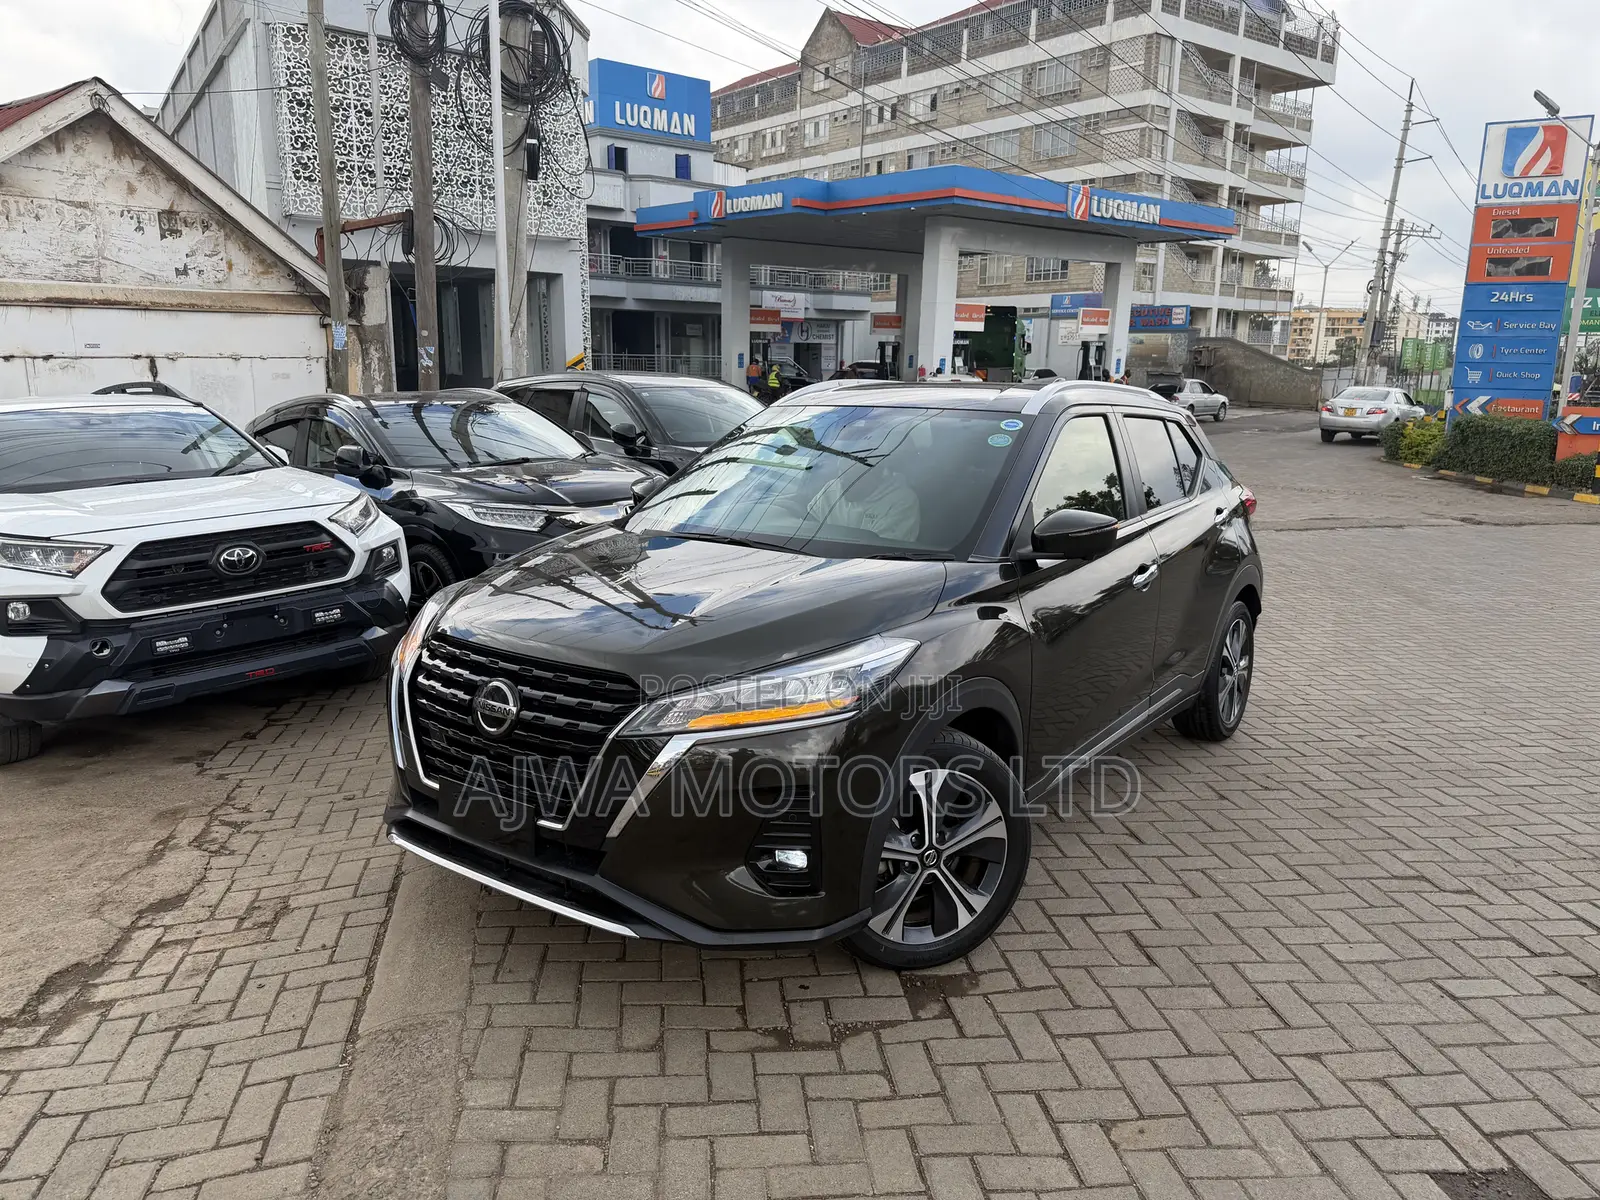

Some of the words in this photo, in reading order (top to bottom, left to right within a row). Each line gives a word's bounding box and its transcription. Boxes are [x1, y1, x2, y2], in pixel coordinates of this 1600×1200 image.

[614, 100, 696, 137] LUQMAN
[1480, 179, 1580, 199] LUQMAN
[726, 192, 784, 214] LUQMAN
[1091, 196, 1161, 224] LUQMAN
[1492, 208, 1520, 216] Diesel
[1487, 246, 1530, 255] Unleaded
[1490, 291, 1534, 303] 24Hrs
[1503, 321, 1536, 329] Service
[1539, 321, 1557, 331] Bay
[1500, 346, 1519, 355] Tyre
[1520, 346, 1548, 355] Center
[1496, 370, 1519, 379] Quick
[1520, 371, 1541, 380] Shop
[1491, 404, 1540, 414] Restaurant
[245, 667, 276, 679] TRD
[478, 700, 516, 718] NISSAN
